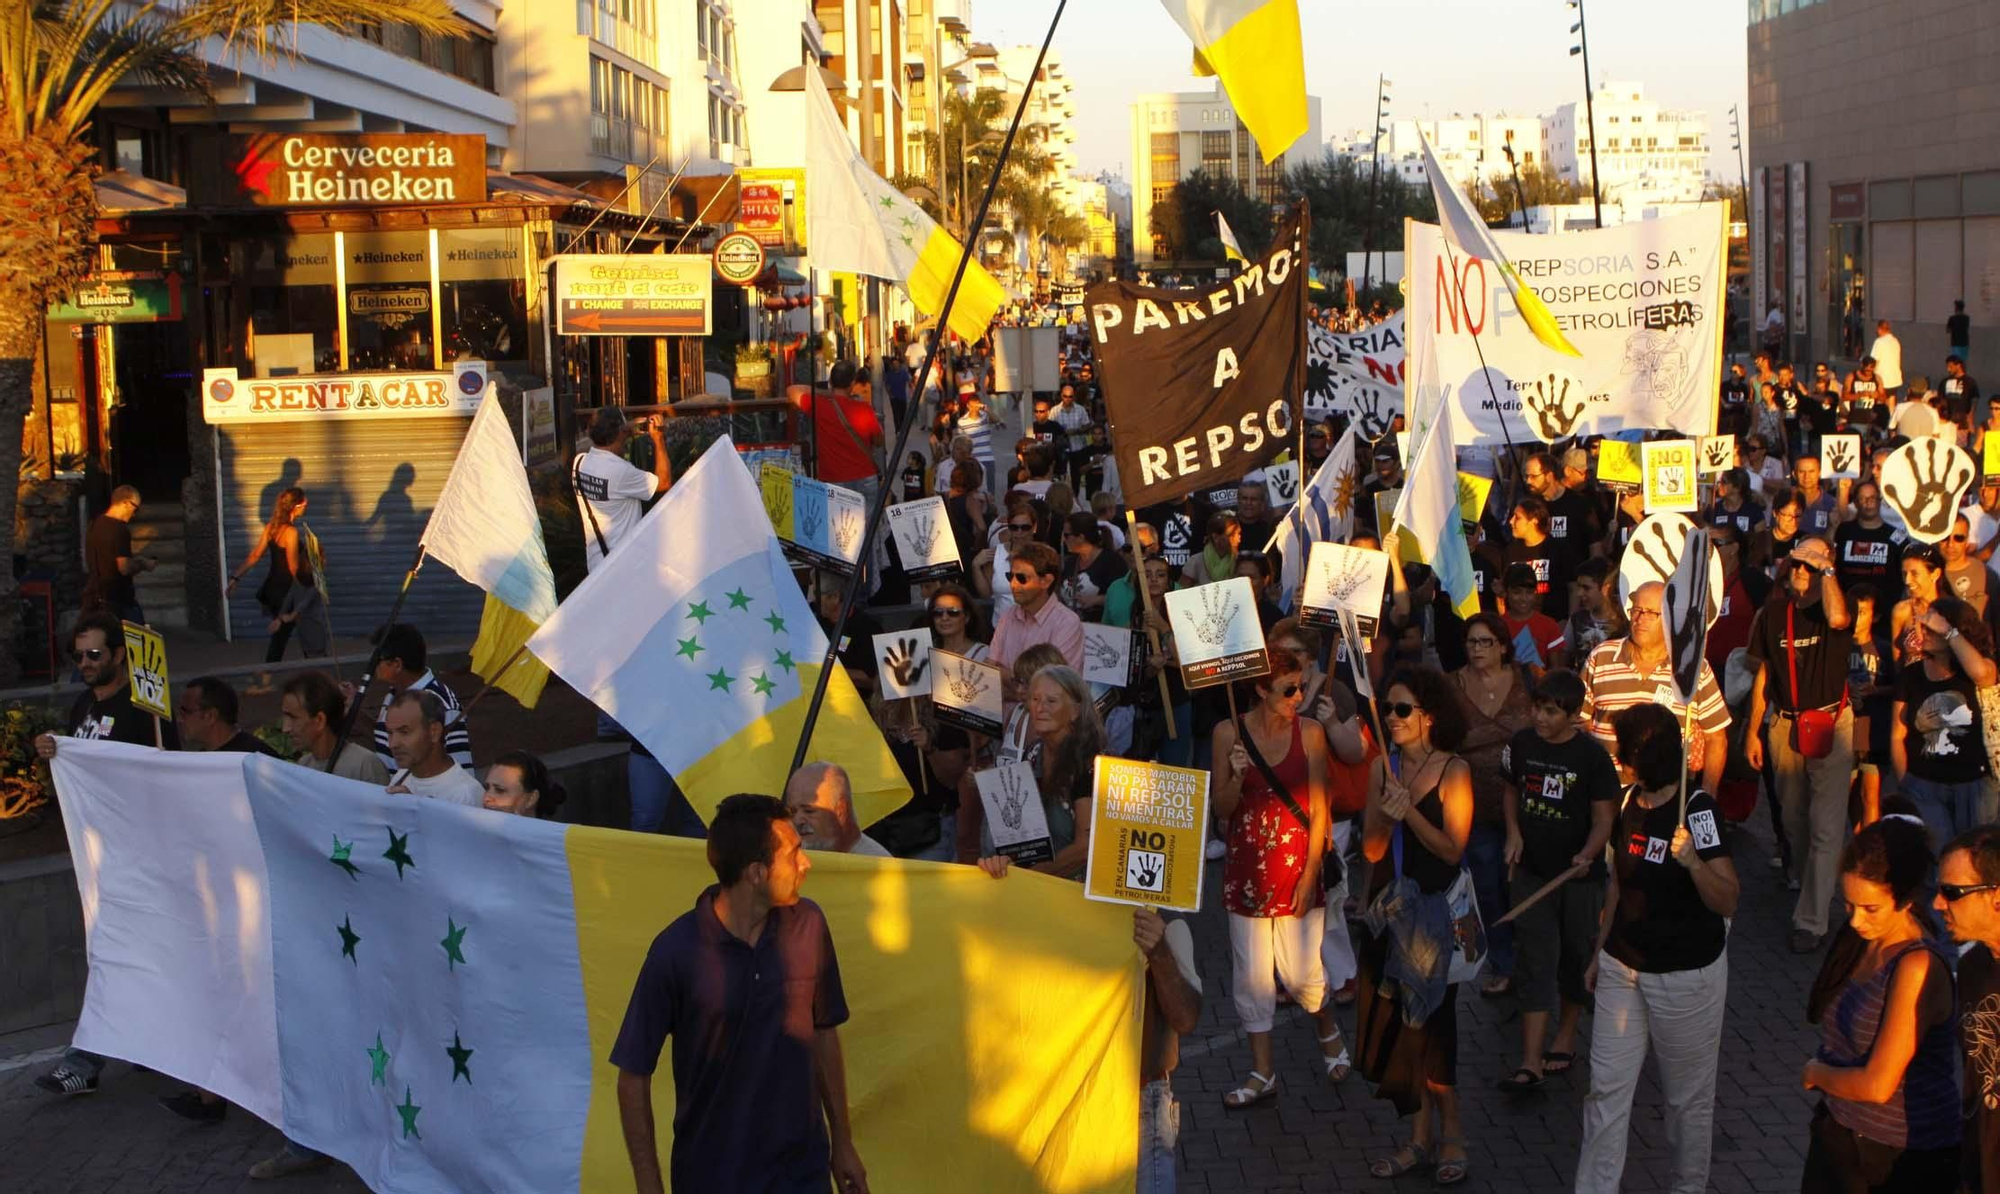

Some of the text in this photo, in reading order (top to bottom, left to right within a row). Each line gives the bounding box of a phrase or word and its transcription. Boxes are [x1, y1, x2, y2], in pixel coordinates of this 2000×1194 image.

[284, 138, 454, 167] Cervecería
[287, 170, 455, 201] Heineken
[363, 251, 424, 263] Heineken
[458, 248, 518, 260] Heineken
[570, 281, 699, 296] rent a car
[1092, 226, 1301, 343] PAREMO
[1435, 254, 1486, 336] NO
[1529, 275, 1702, 303] OSPECCIONES
[80, 294, 130, 305] Heineken
[357, 294, 423, 308] Heineken
[582, 300, 623, 309] CHANGE
[650, 300, 703, 310] EXCHANGE
[1555, 303, 1704, 331] ETROLÍFERAS
[1308, 321, 1405, 364] CERIA
[1213, 347, 1241, 388] A
[250, 379, 449, 411] RENT A CAR
[1658, 450, 1683, 465] NO
[827, 489, 835, 498] 18
[890, 507, 902, 518] 18
[1205, 668, 1216, 676] NO
[134, 675, 166, 710] VOZ
[1109, 763, 1147, 776] SOMOS
[1108, 773, 1196, 795] NO PASARAN
[1108, 784, 1195, 810] NI REPSOL
[1106, 799, 1194, 822] NI MENTIRAS
[1106, 811, 1119, 819] NO
[1120, 812, 1150, 824] VAMOS
[1160, 818, 1194, 830] CALLAR
[1130, 829, 1166, 851] NO
[1628, 843, 1646, 856] NO
[1116, 828, 1128, 888] EN CANARIAS
